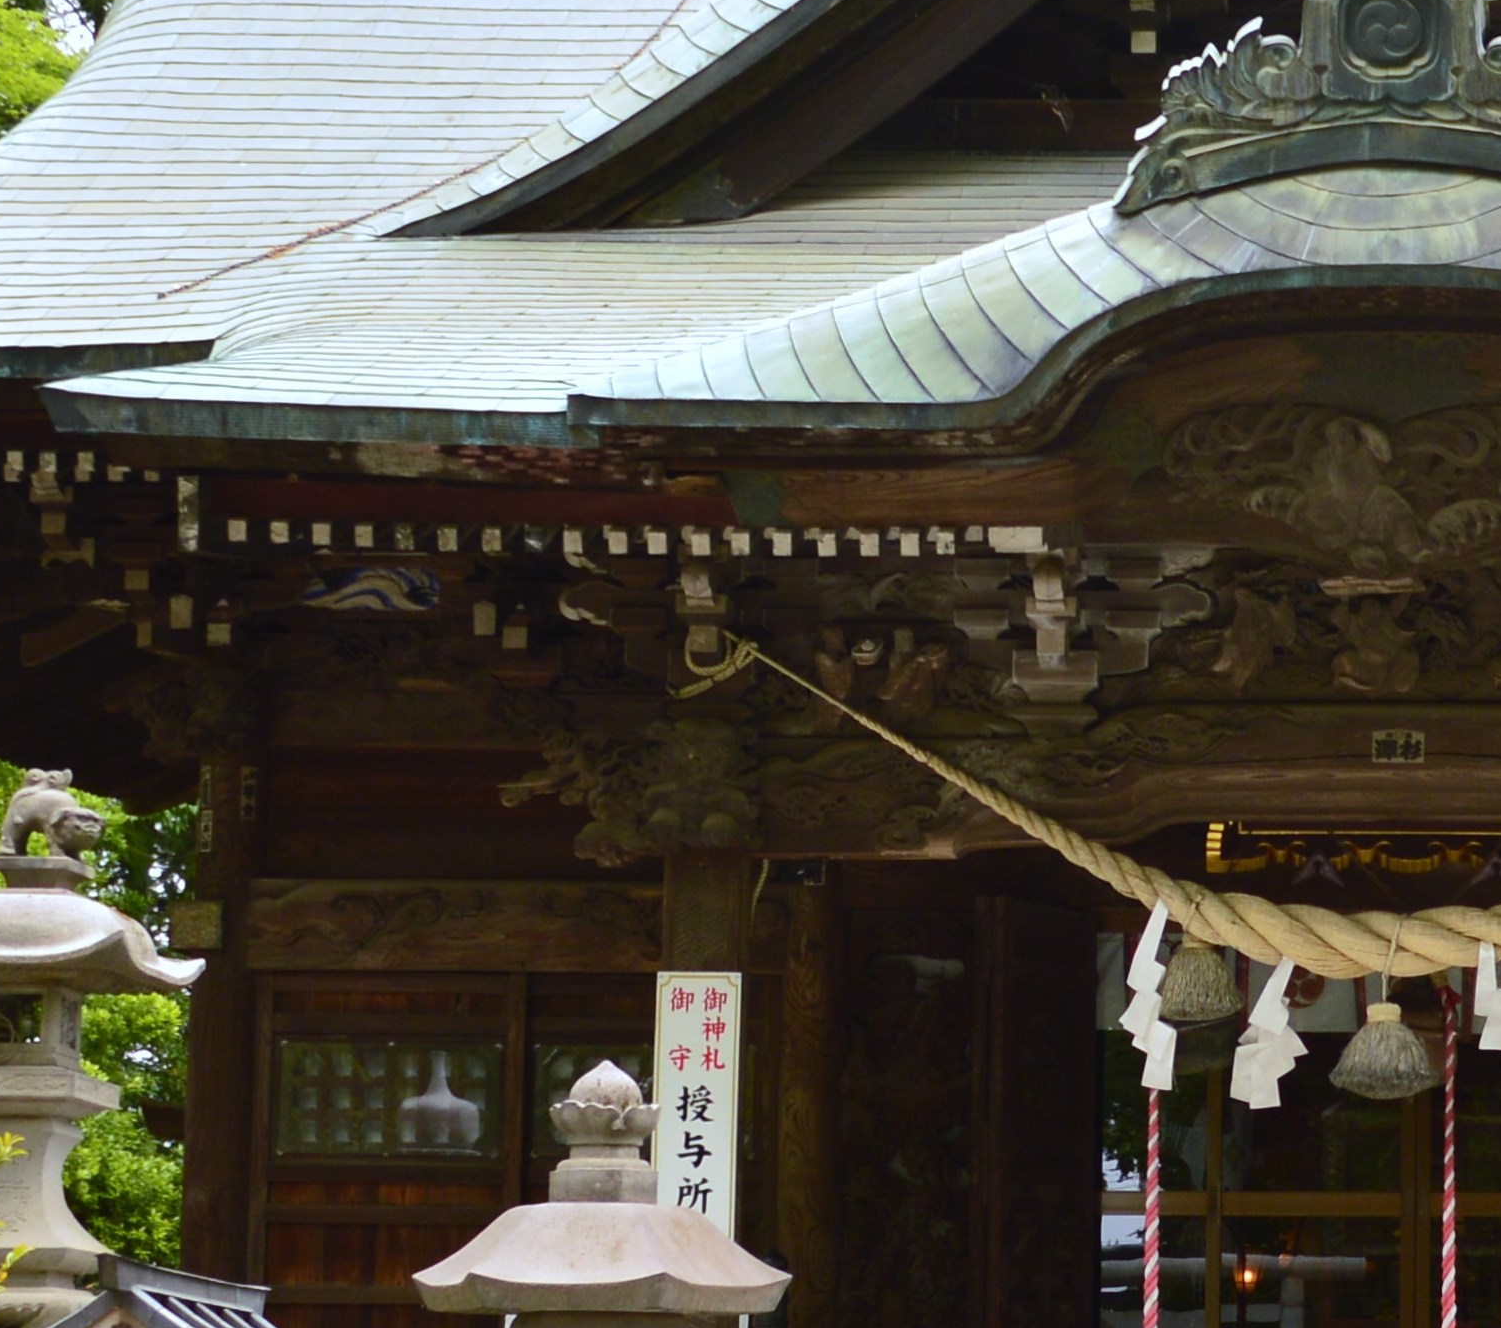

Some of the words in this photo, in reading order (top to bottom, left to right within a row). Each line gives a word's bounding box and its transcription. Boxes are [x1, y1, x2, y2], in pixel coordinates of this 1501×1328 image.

[668, 987, 695, 1072] 御守
[700, 987, 728, 1072] 御神札
[675, 1084, 714, 1215] 授与所
